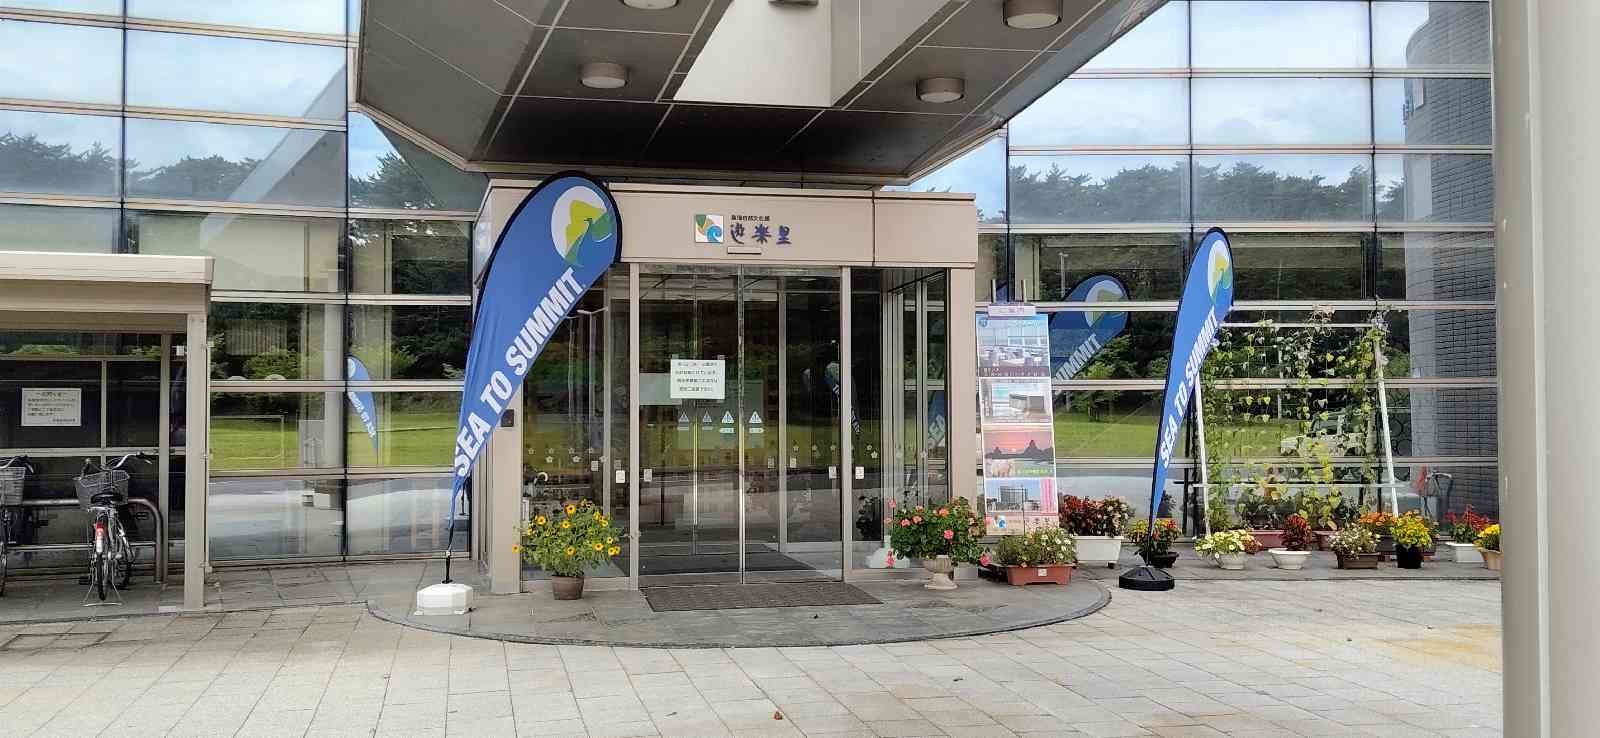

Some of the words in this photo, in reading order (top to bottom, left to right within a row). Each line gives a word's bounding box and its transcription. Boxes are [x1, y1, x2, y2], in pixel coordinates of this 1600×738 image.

[454, 411, 491, 478] SEA
[480, 370, 513, 415] TO
[505, 267, 584, 377] SUMMIT
[1051, 333, 1101, 382] UMMIT
[1161, 414, 1178, 468] SEA
[1174, 381, 1188, 416] TO
[1185, 305, 1218, 386] SUMMIT
